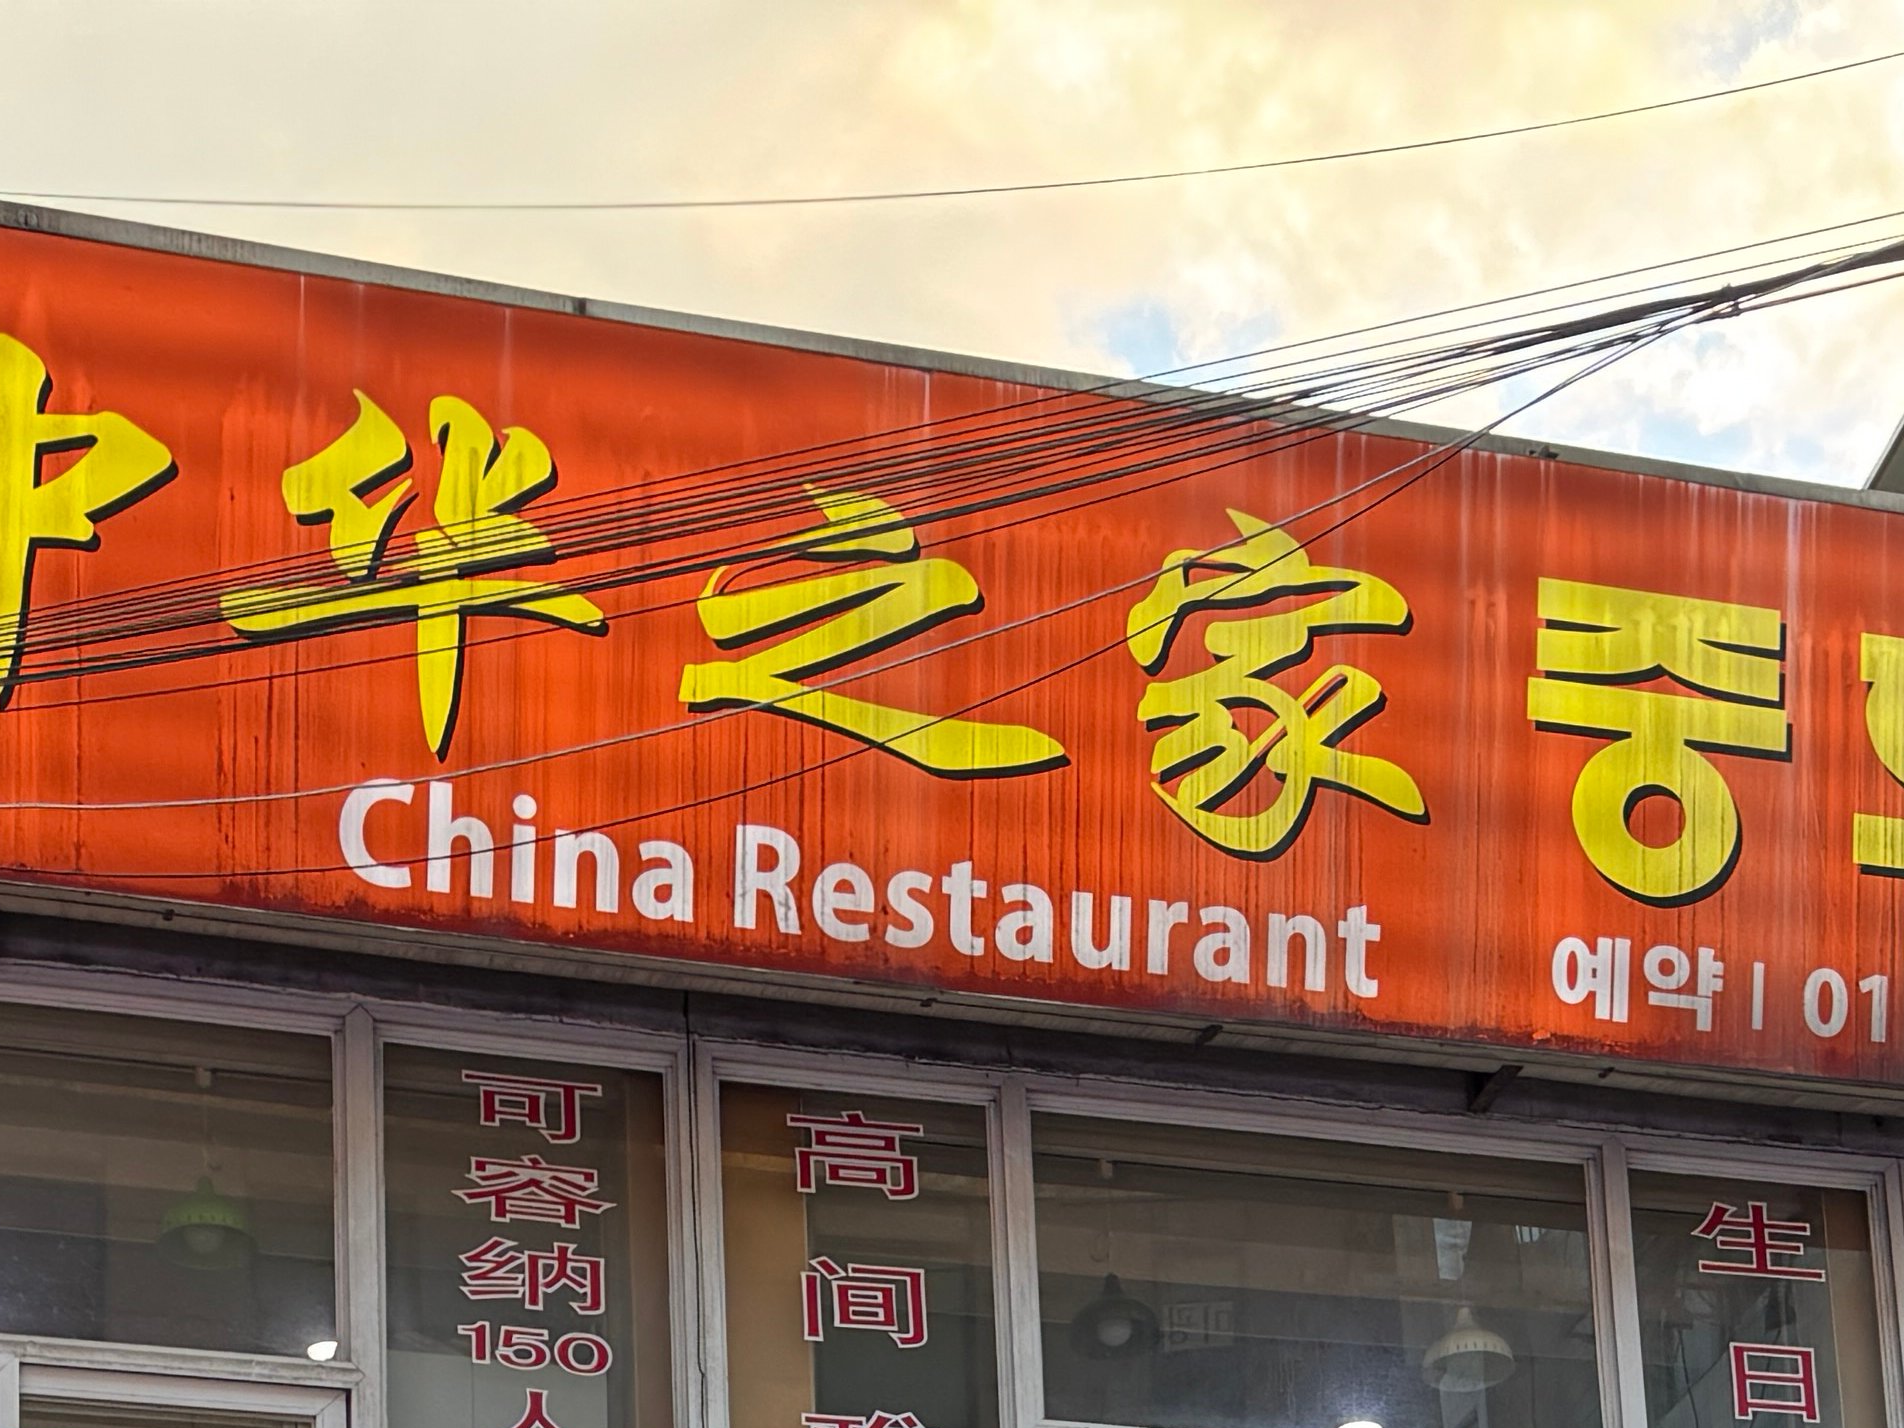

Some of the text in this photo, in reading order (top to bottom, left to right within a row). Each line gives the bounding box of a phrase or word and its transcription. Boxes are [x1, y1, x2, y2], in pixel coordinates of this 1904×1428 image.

[338, 778, 1382, 999] China Restaurant
[1551, 934, 1725, 1034] 예약
